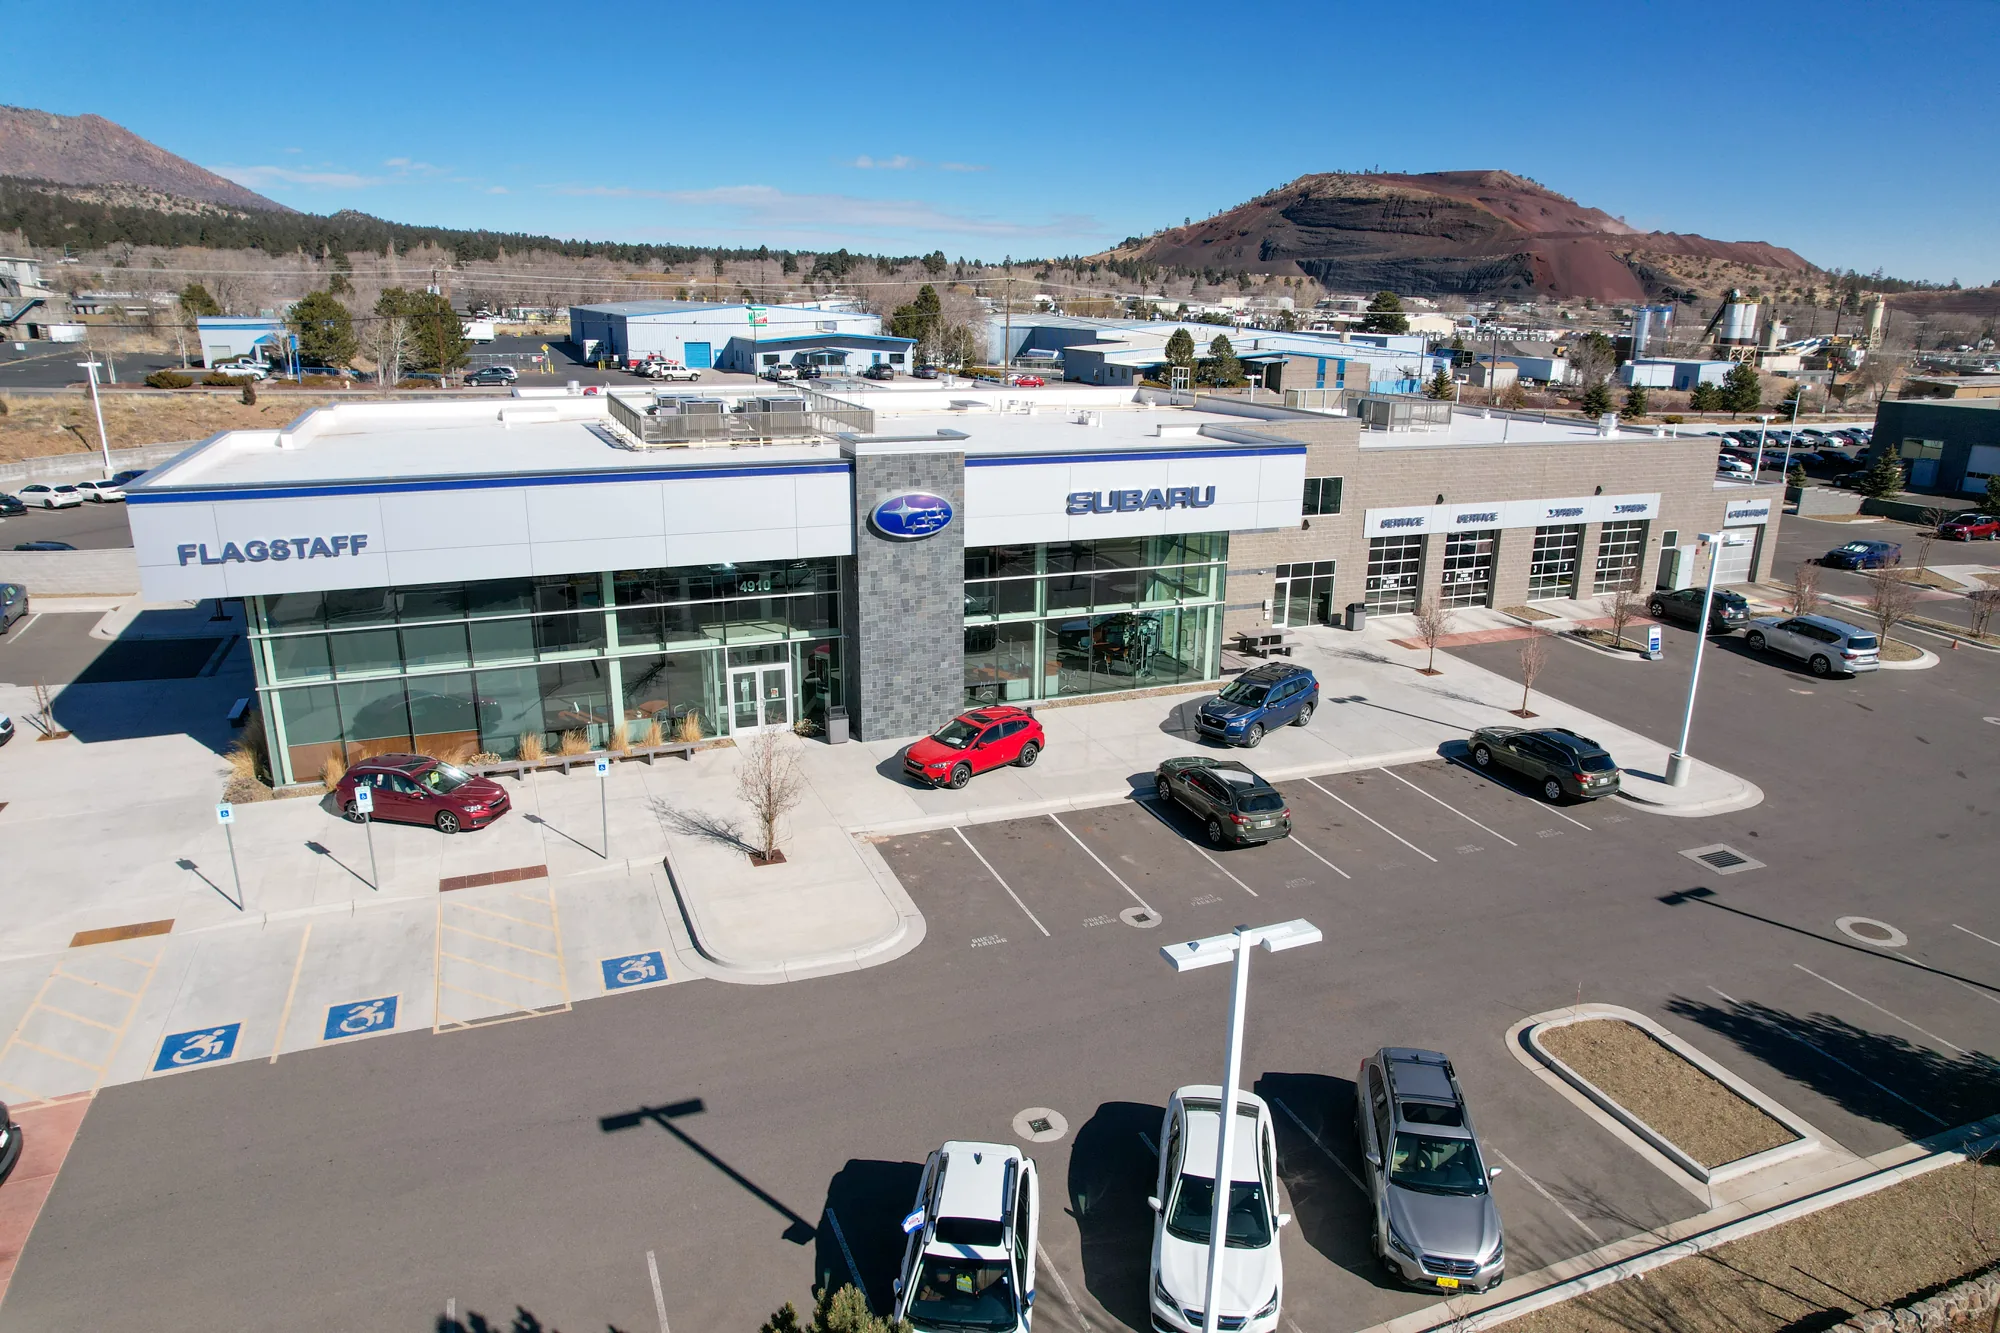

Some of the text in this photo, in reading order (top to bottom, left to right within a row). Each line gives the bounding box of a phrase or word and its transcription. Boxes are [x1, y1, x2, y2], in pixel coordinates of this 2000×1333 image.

[1066, 485, 1216, 516] SUBARU
[1380, 516, 1425, 529] SERVICE
[1456, 511, 1499, 524] SERVICE
[177, 534, 368, 567] FLAGSTAFF
[740, 580, 771, 592] 4910
[970, 937, 1008, 949] PARKING
[971, 934, 1000, 944] GUEST
